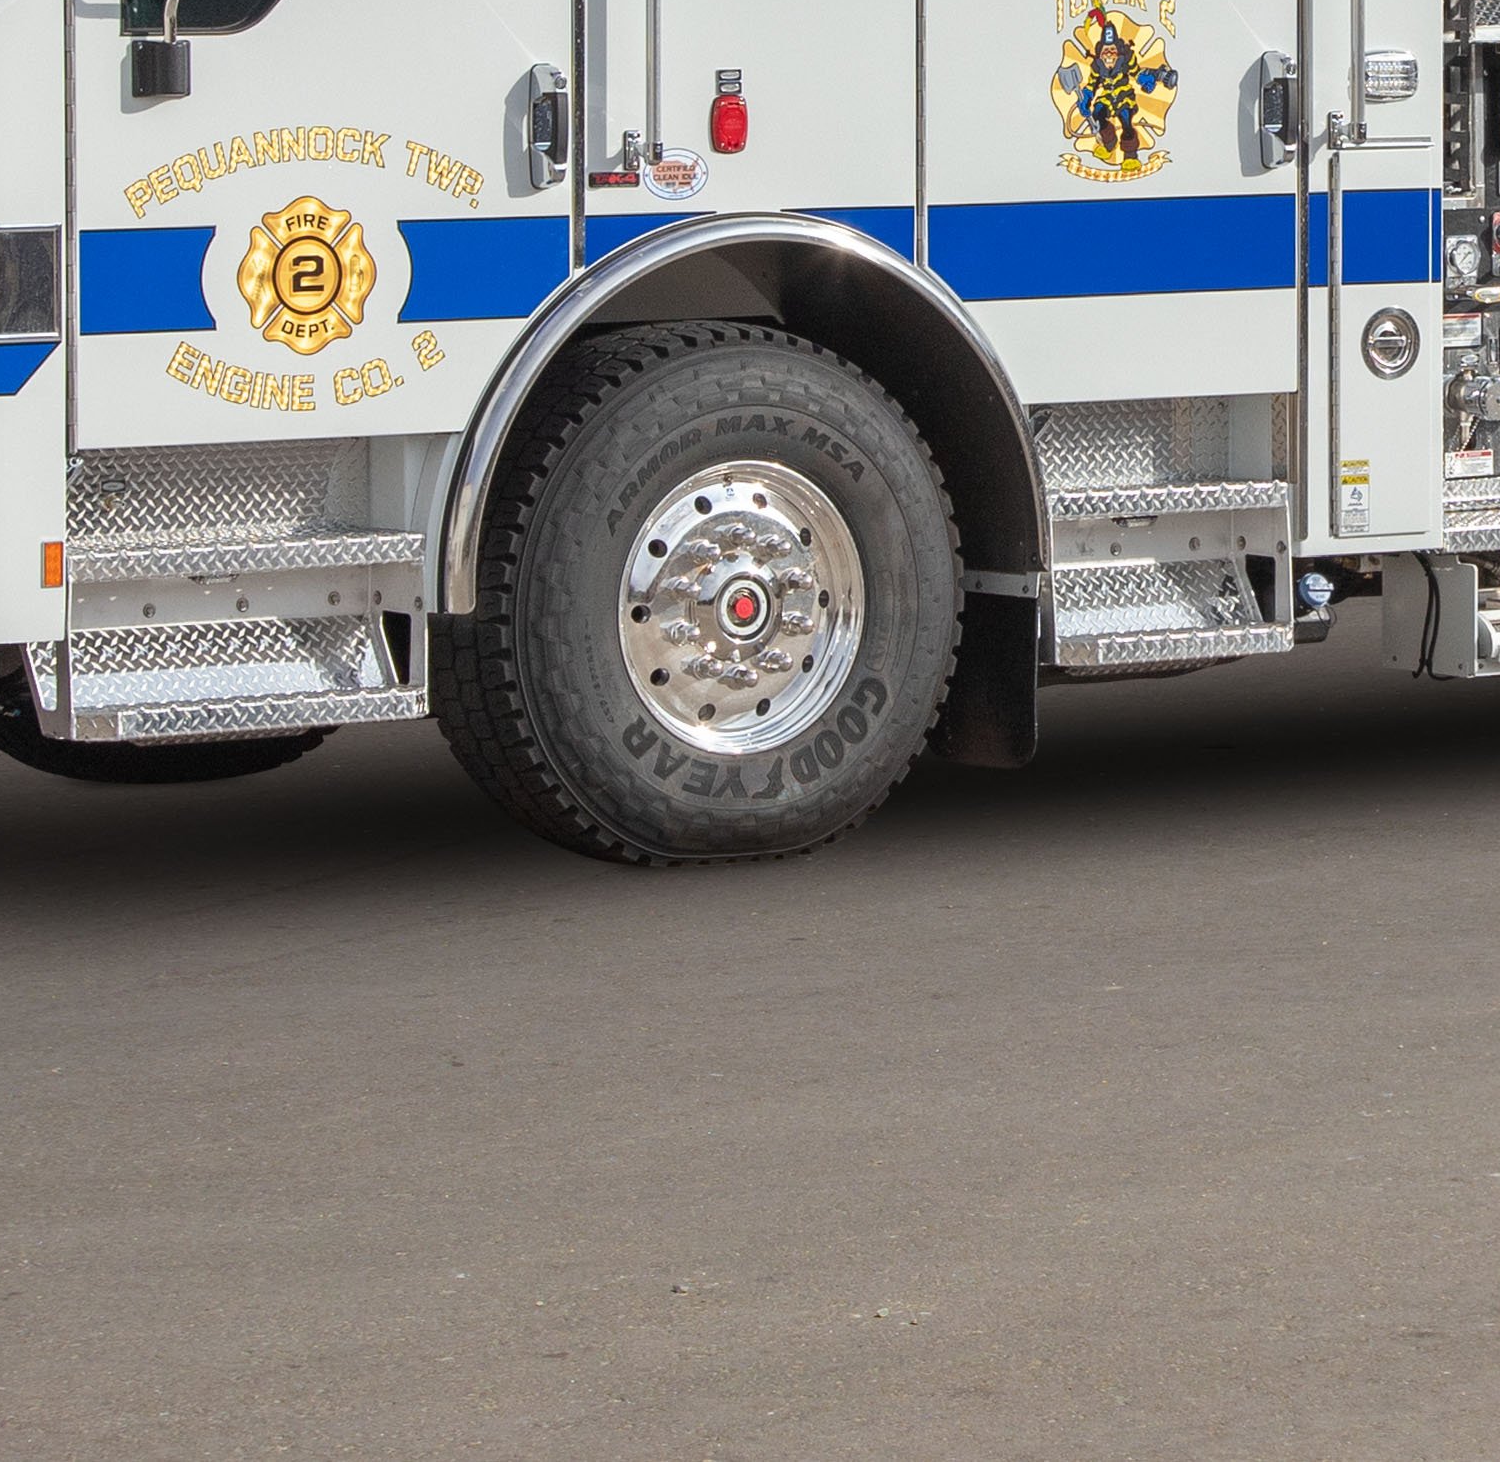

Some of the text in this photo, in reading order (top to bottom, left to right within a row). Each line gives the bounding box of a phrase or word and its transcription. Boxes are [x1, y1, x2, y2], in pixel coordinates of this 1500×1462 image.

[1105, 29, 1114, 43] 2
[123, 125, 486, 219] PEQUANNOCK TWP.
[285, 213, 329, 232] FIRE
[288, 255, 325, 293] 2
[281, 318, 335, 339] DEPT.
[167, 330, 446, 412] ENGINE CO. 2
[607, 414, 866, 537] ARMOR MAX MSA
[622, 677, 888, 800] GOODYEAR
